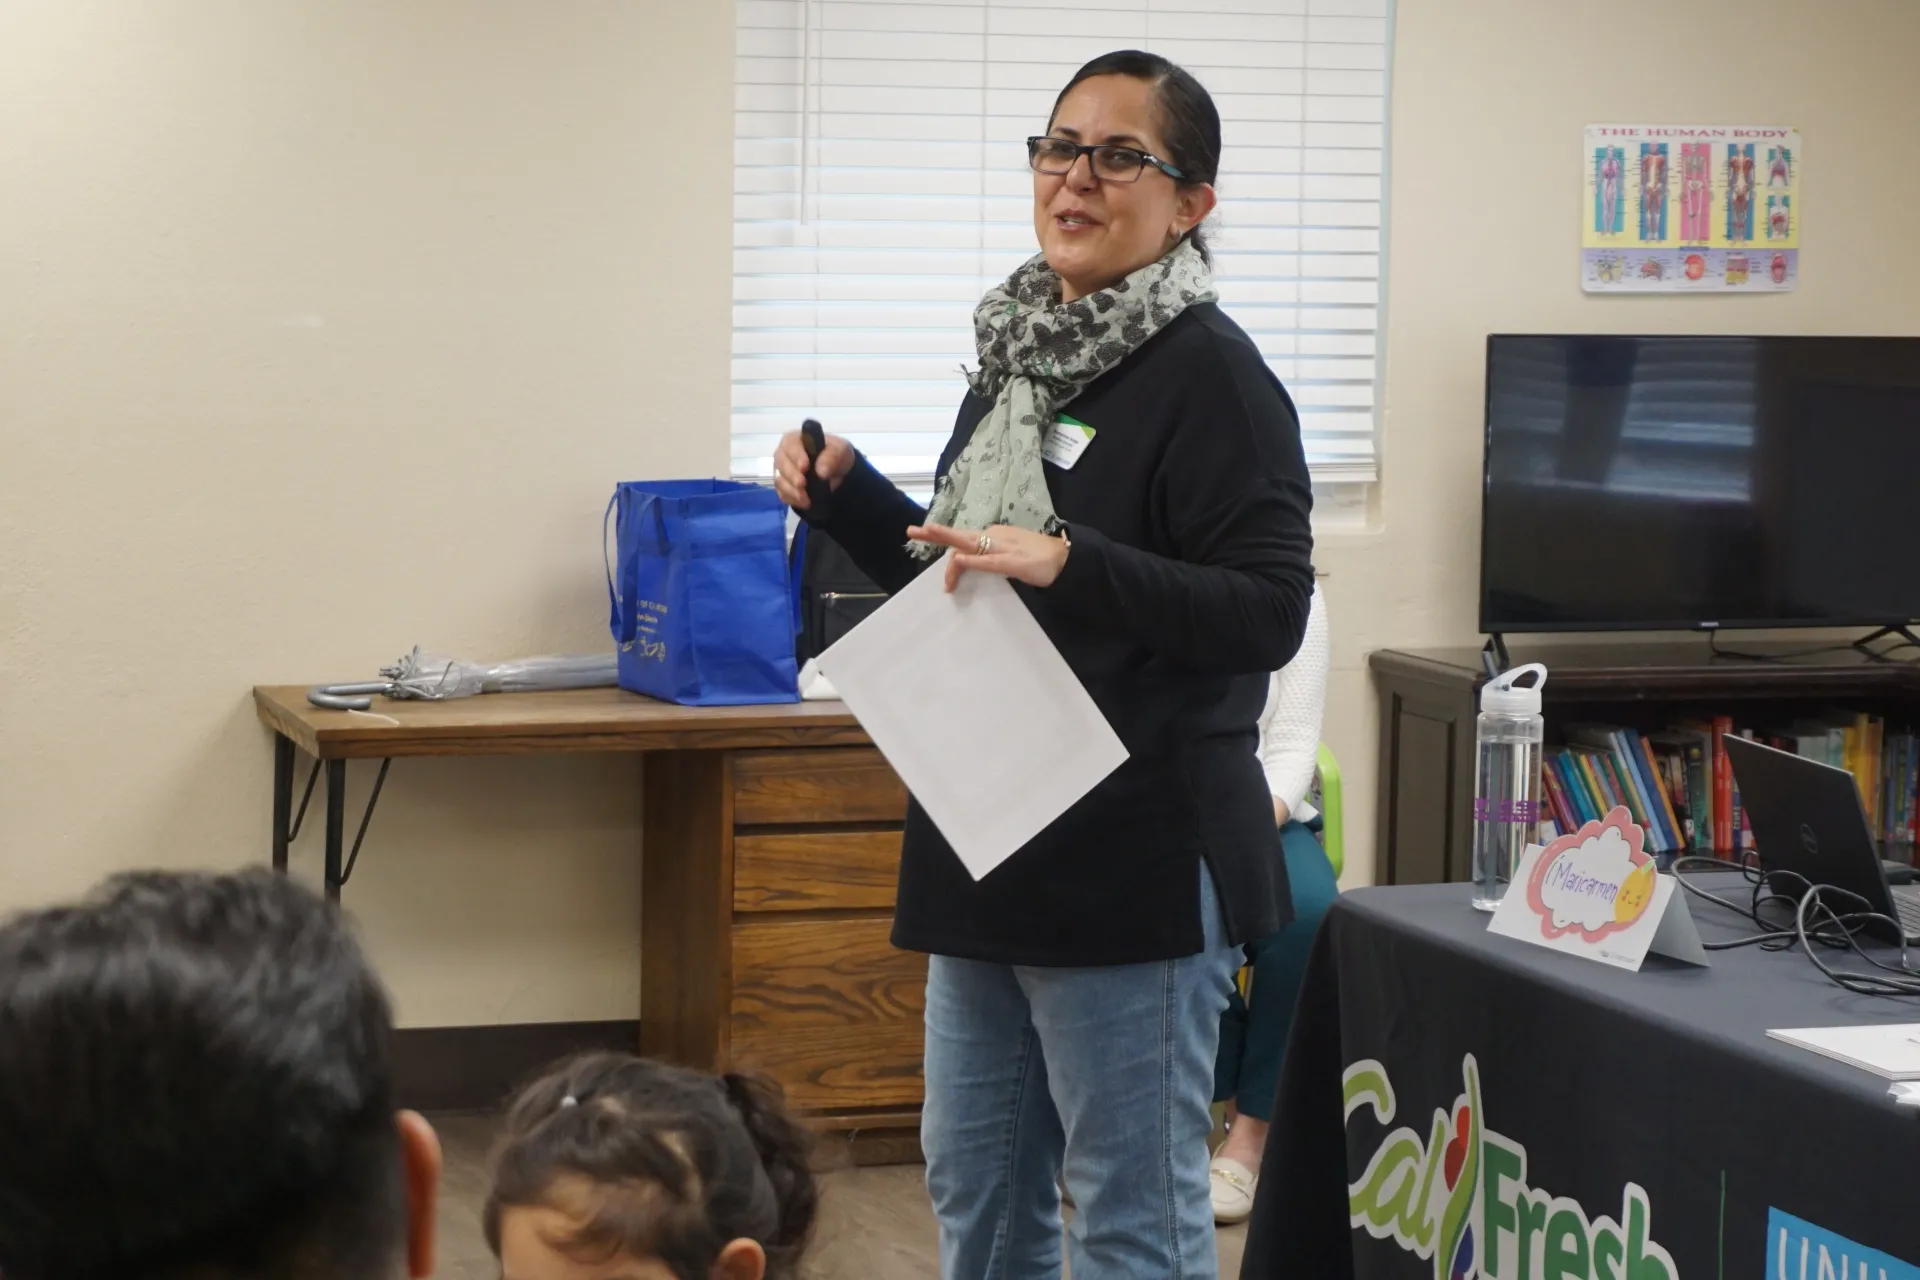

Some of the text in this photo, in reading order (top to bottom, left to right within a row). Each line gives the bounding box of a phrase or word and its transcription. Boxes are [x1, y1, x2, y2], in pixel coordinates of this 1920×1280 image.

[1600, 128, 1788, 138] THE HUMAN BODY
[1553, 862, 1618, 904] Maricarmen
